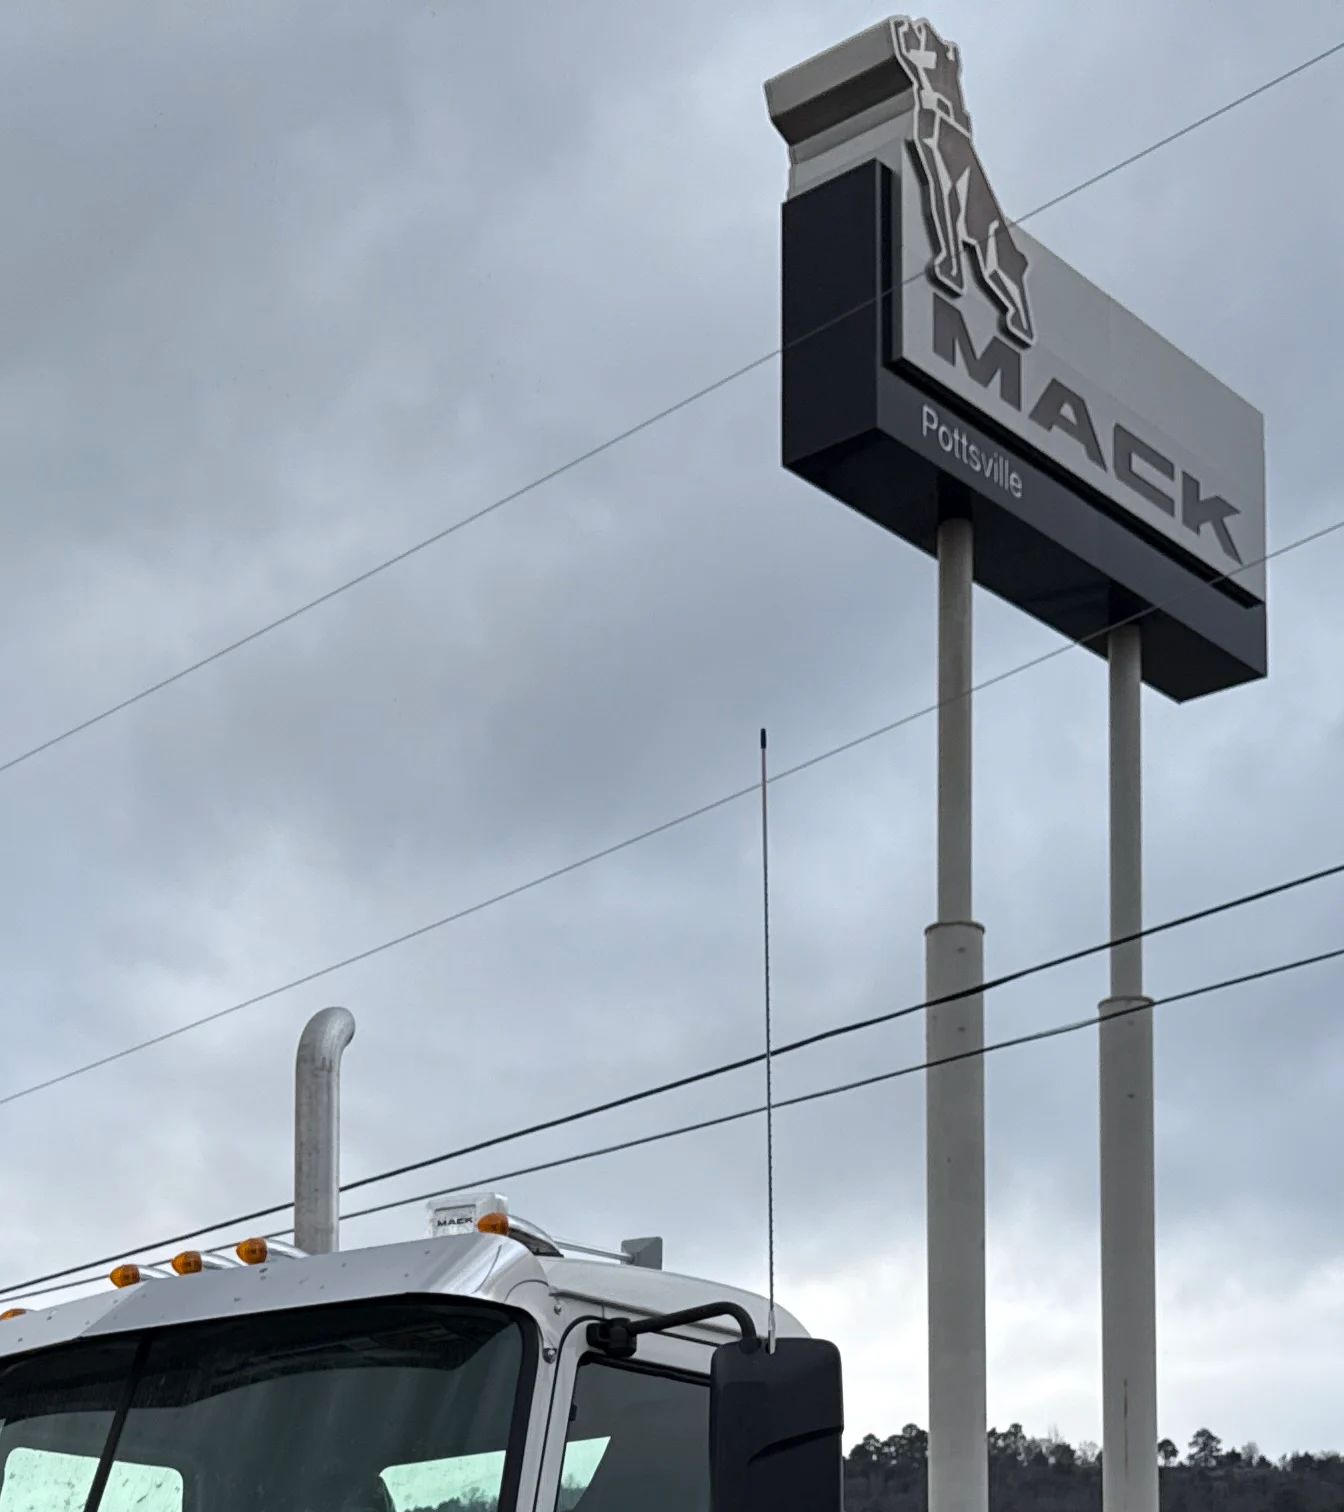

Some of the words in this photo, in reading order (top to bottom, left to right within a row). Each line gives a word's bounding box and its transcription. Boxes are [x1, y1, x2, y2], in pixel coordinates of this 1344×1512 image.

[921, 404, 1023, 499] Pottsville
[932, 291, 1244, 566] MACK
[437, 1217, 473, 1227] MACK
